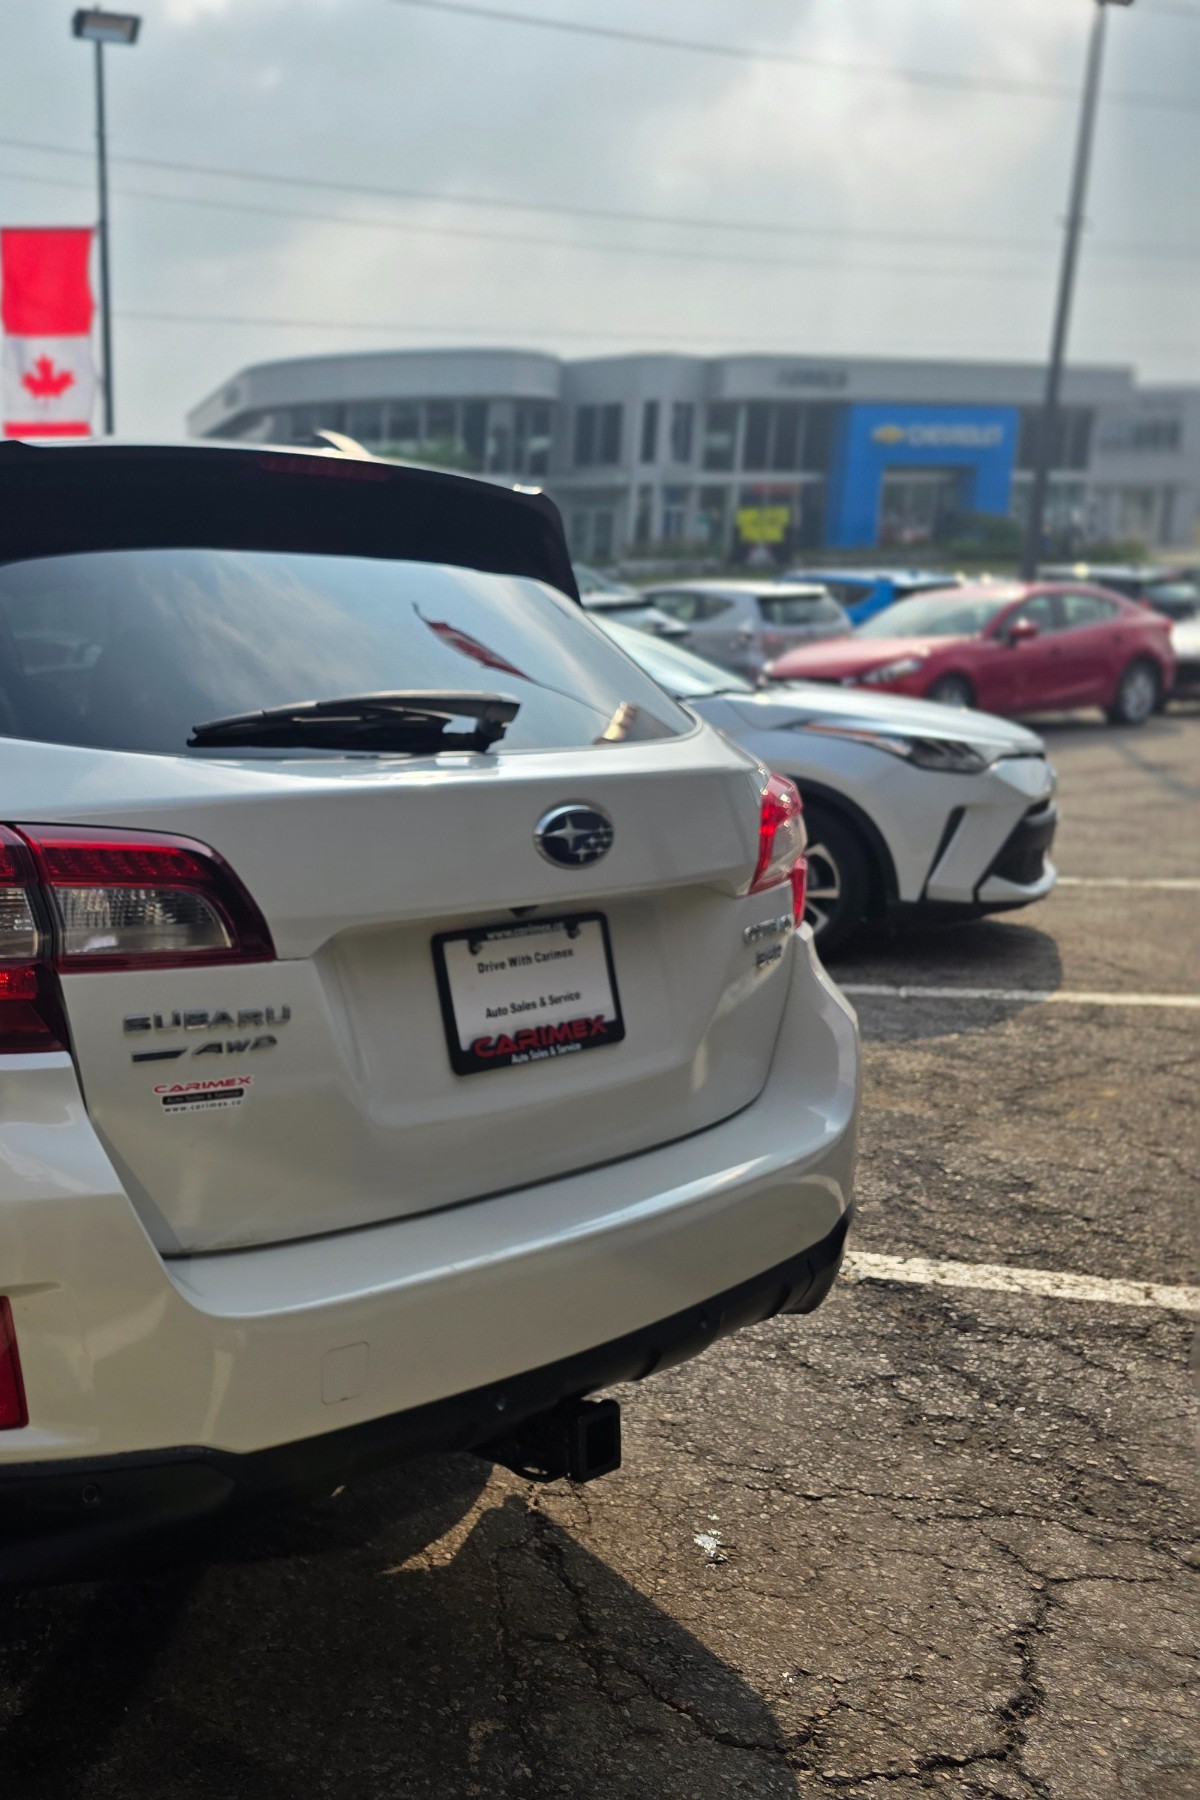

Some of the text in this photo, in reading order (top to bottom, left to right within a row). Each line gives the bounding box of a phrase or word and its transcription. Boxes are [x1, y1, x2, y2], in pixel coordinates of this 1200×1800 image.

[477, 948, 574, 974] Drive With Carimex
[486, 991, 581, 1019] Auto Sales & Service
[123, 1005, 291, 1033] SUBARU
[191, 1034, 278, 1056] AWD
[474, 1015, 607, 1057] CARIMEX
[511, 1042, 582, 1065] Auto Sales & Service
[153, 1075, 252, 1094] CARIMEX
